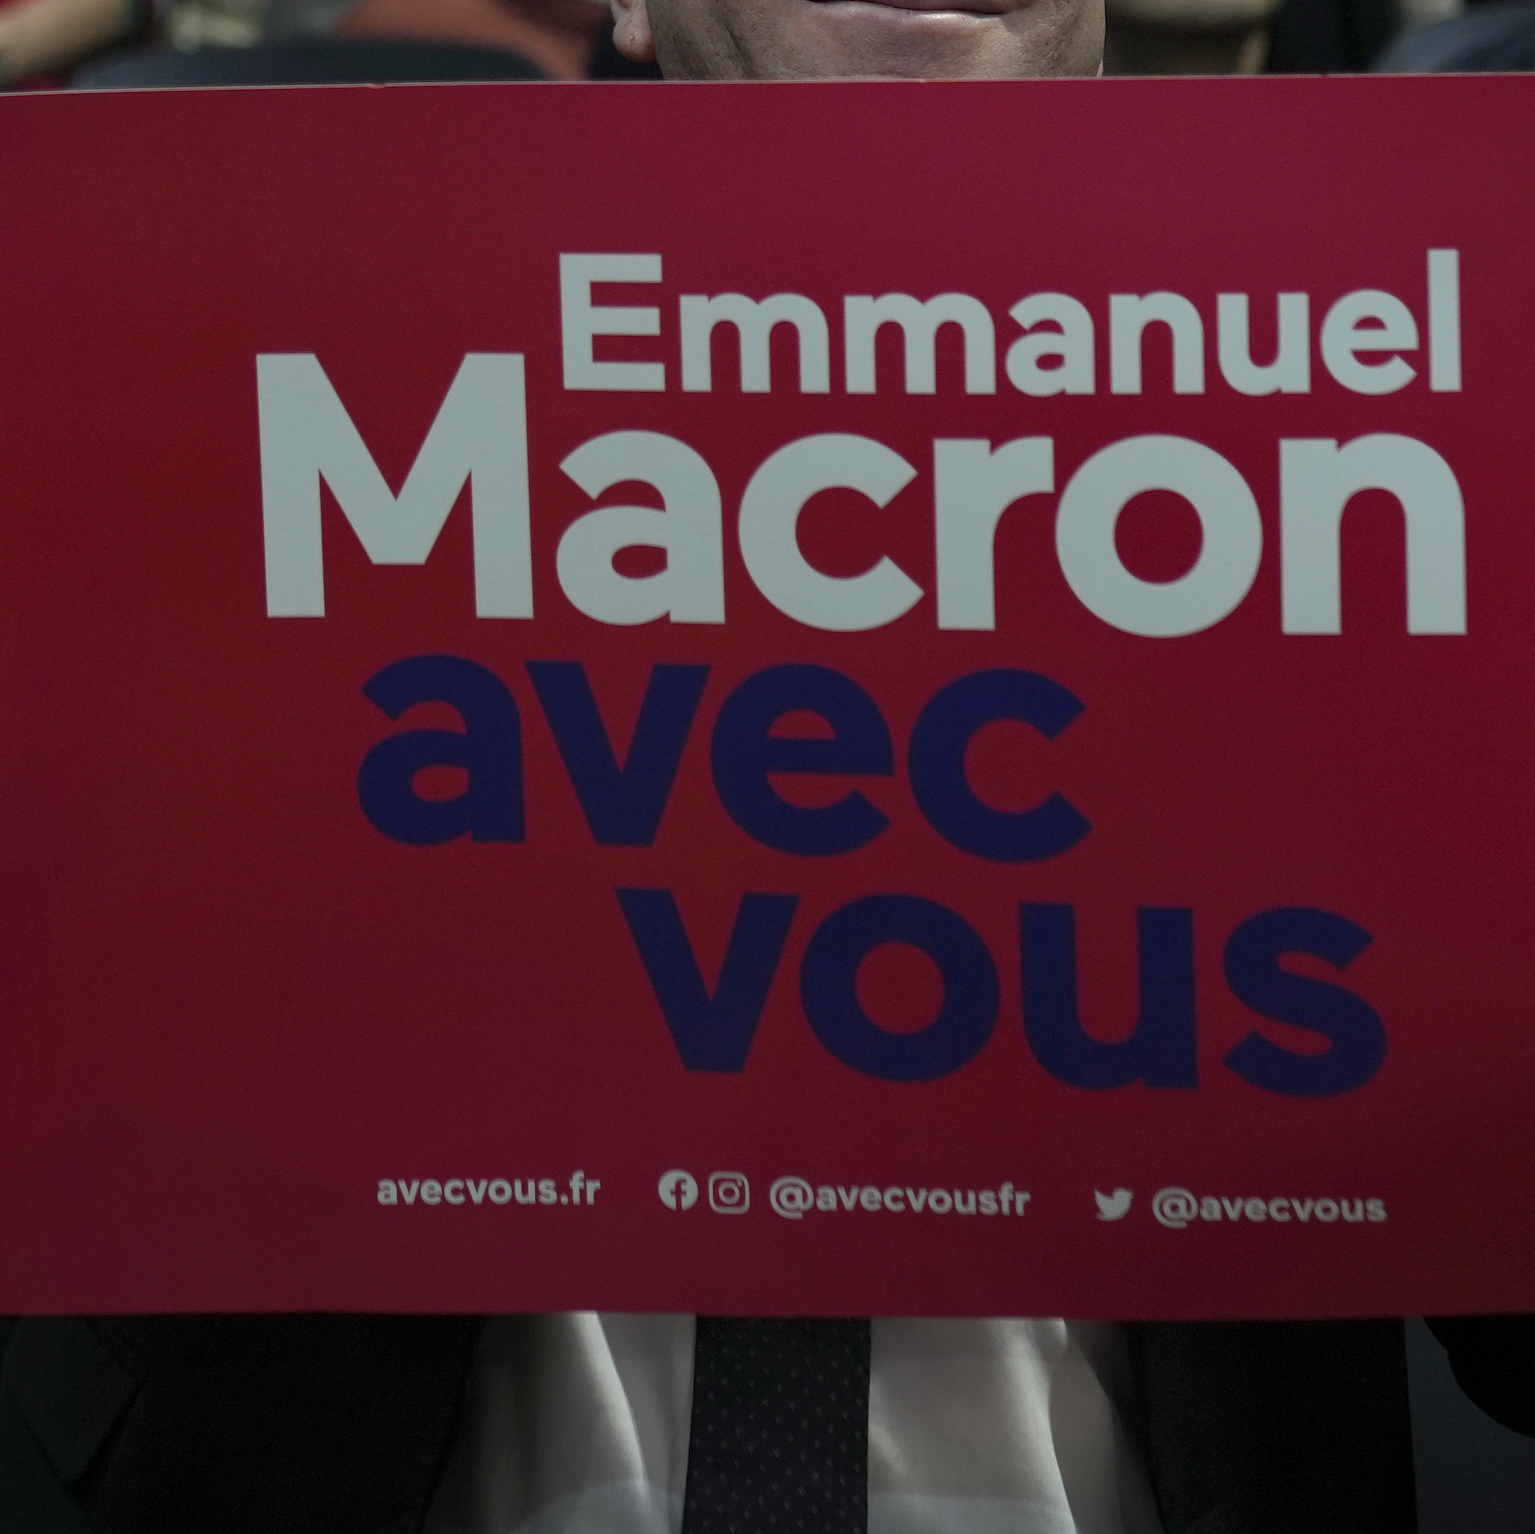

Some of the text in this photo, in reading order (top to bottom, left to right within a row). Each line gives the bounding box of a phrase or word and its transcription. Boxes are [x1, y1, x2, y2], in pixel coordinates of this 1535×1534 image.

[558, 248, 1463, 397] Emmanuel
[255, 352, 1468, 638] Macron
[357, 655, 1091, 863] avec
[616, 888, 1386, 1098] vous
[376, 1170, 1388, 1227] avecvous.fr @avecvousfr @avecvous
